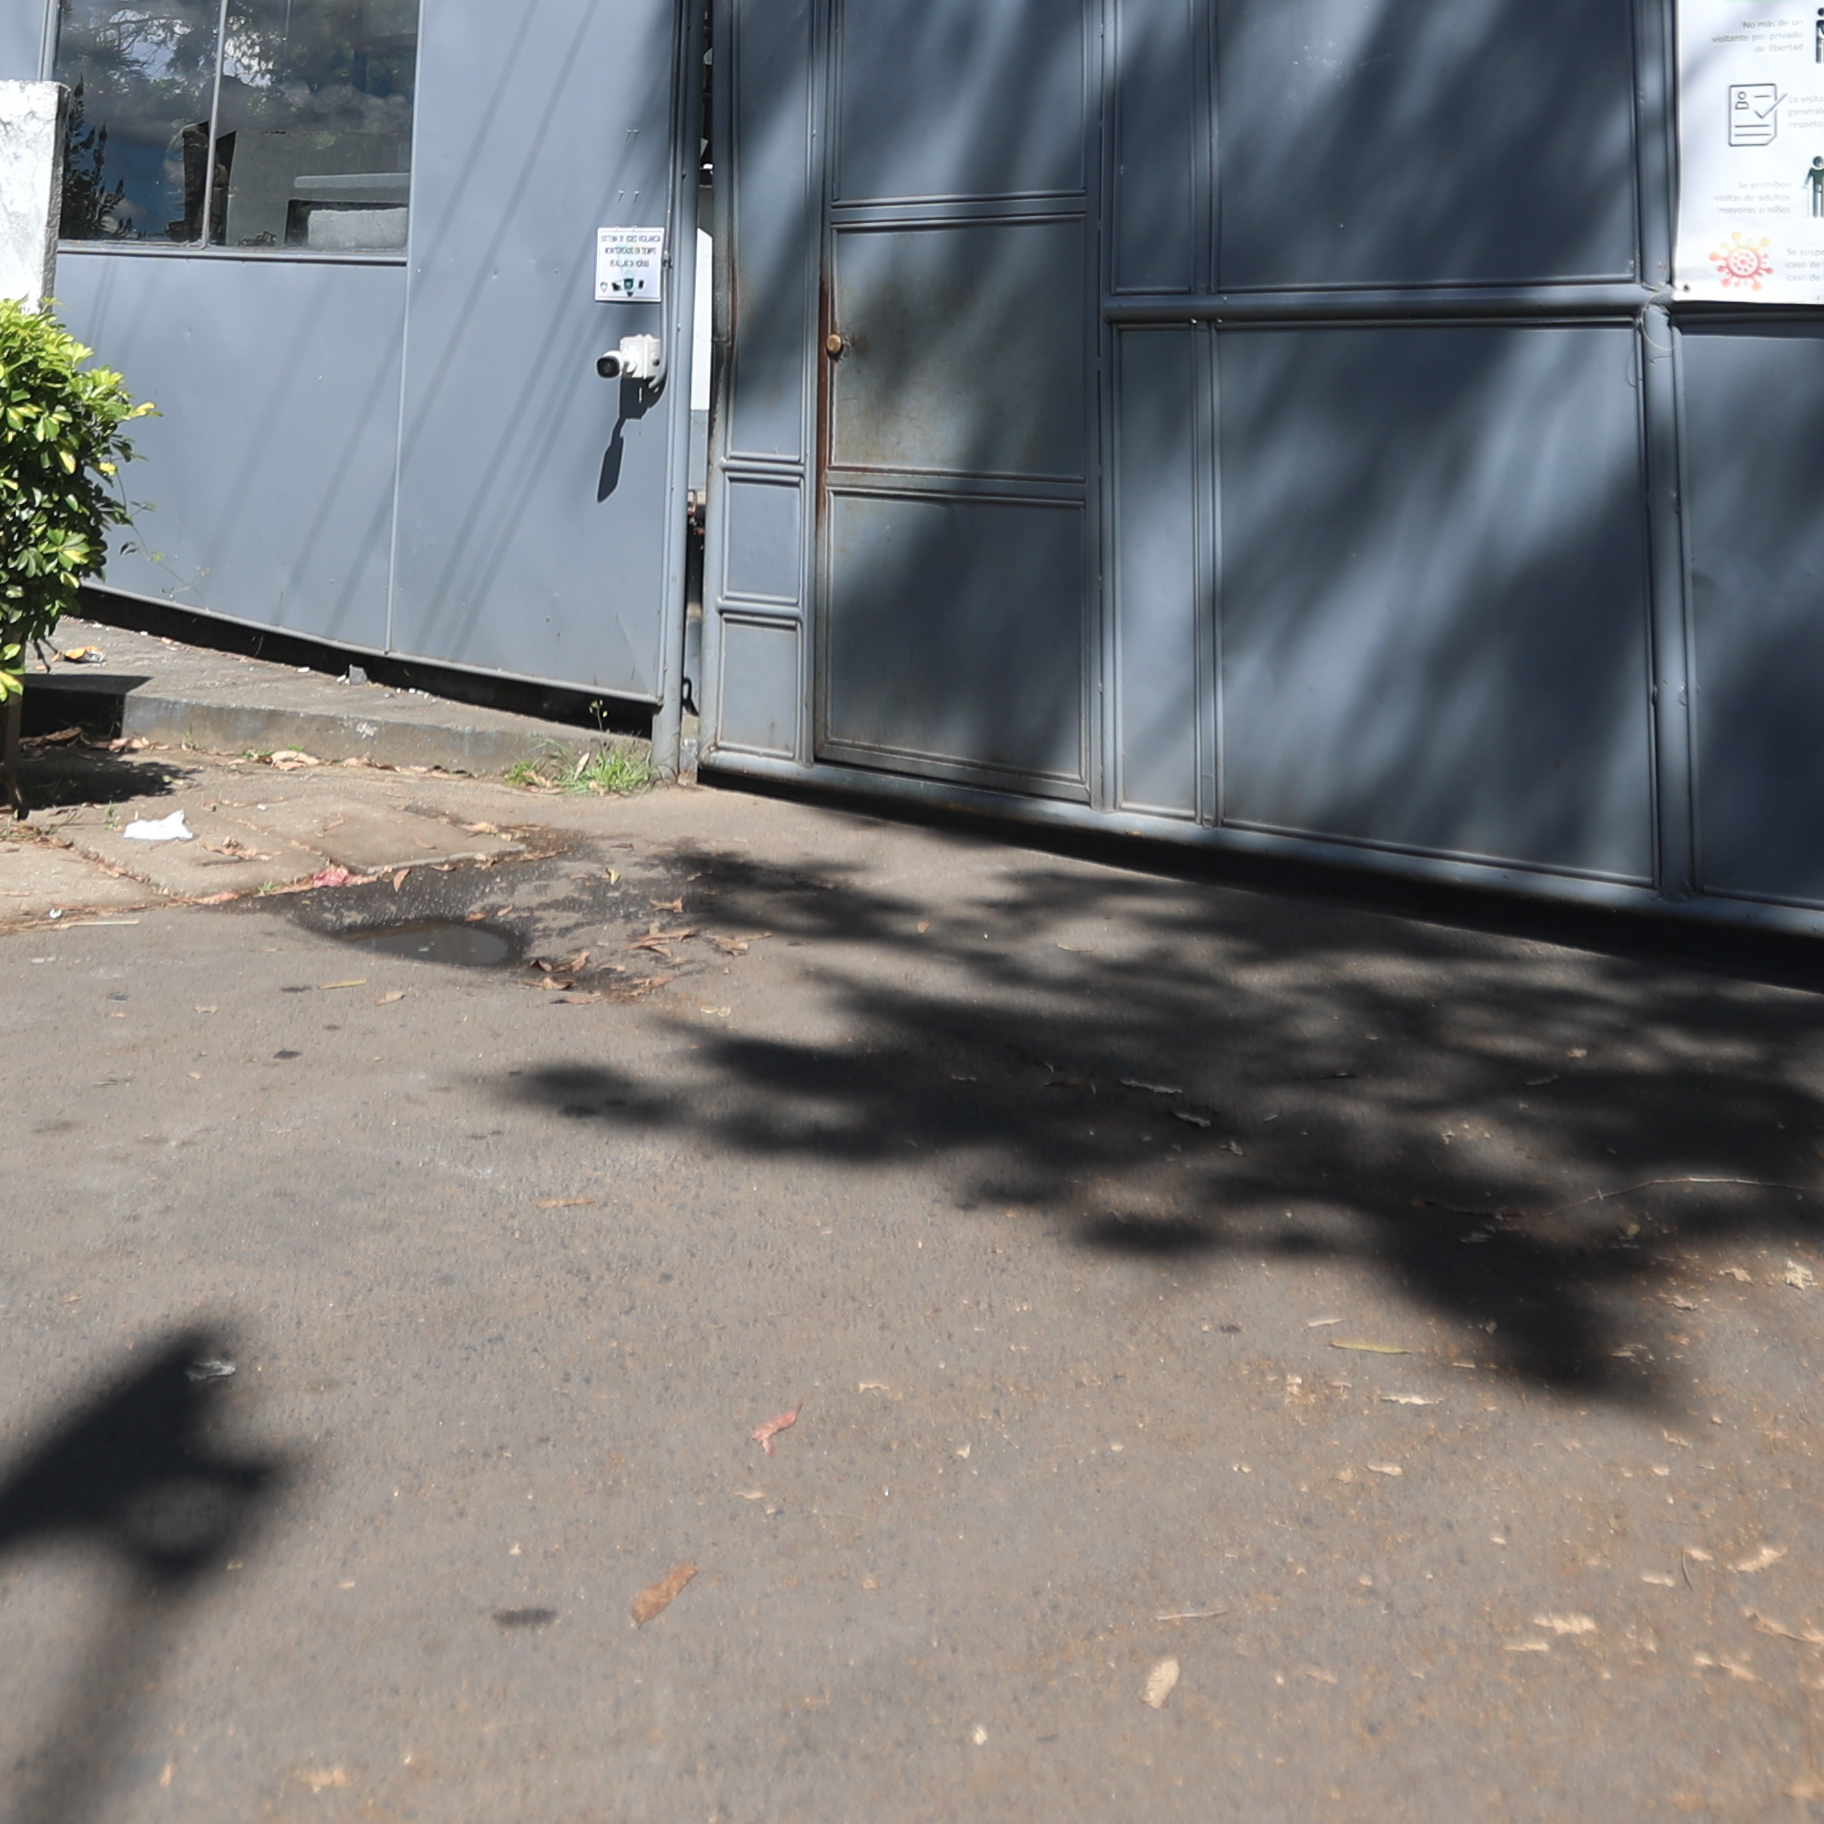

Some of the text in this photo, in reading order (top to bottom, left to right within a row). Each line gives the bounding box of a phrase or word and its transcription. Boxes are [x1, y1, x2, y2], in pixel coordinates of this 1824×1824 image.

[1743, 21, 1756, 29] No
[1712, 34, 1750, 43] visitante
[1770, 31, 1804, 40] privado
[1769, 43, 1803, 51] libertad
[1789, 95, 1799, 103] La
[1801, 94, 1824, 102] visita
[1789, 120, 1823, 129] respeto
[1737, 181, 1748, 189] Se
[1787, 248, 1797, 256] Se
[1809, 260, 1822, 269] de
[1787, 274, 1807, 282] caso
[1810, 273, 1821, 282] de
